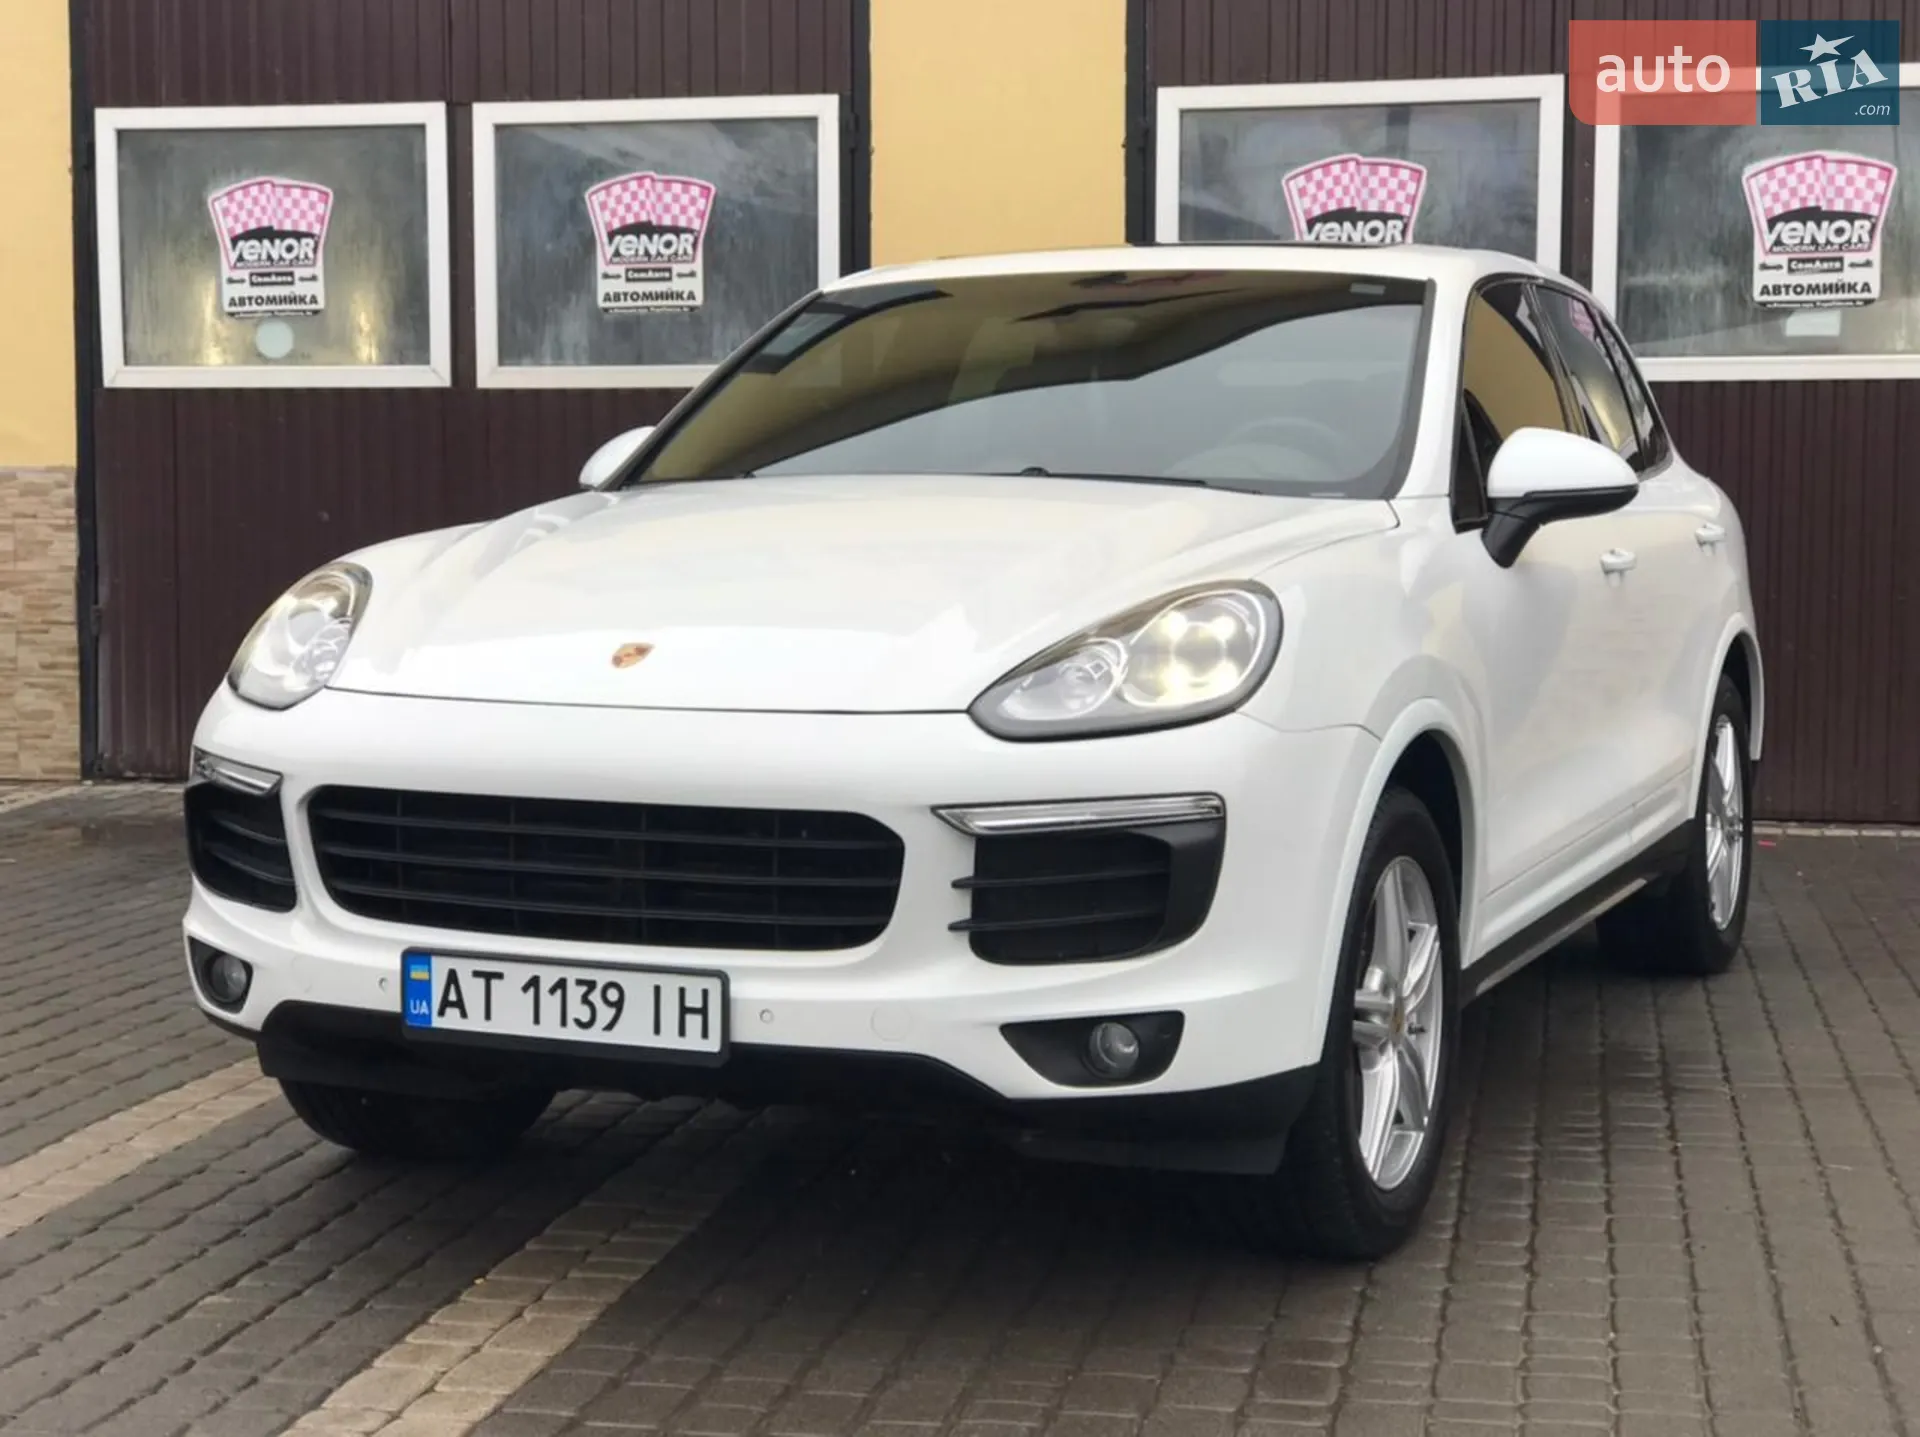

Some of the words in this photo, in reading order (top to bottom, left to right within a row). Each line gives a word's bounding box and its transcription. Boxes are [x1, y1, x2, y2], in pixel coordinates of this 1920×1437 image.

[602, 287, 696, 302] АВТОМИЙКА
[1759, 279, 1872, 296] АВТОМИЙКА
[228, 292, 318, 307] АВТОМИЙКА
[410, 1000, 429, 1015] UA
[437, 968, 504, 1021] AT
[521, 974, 626, 1031] 1139
[653, 984, 709, 1040] IH
